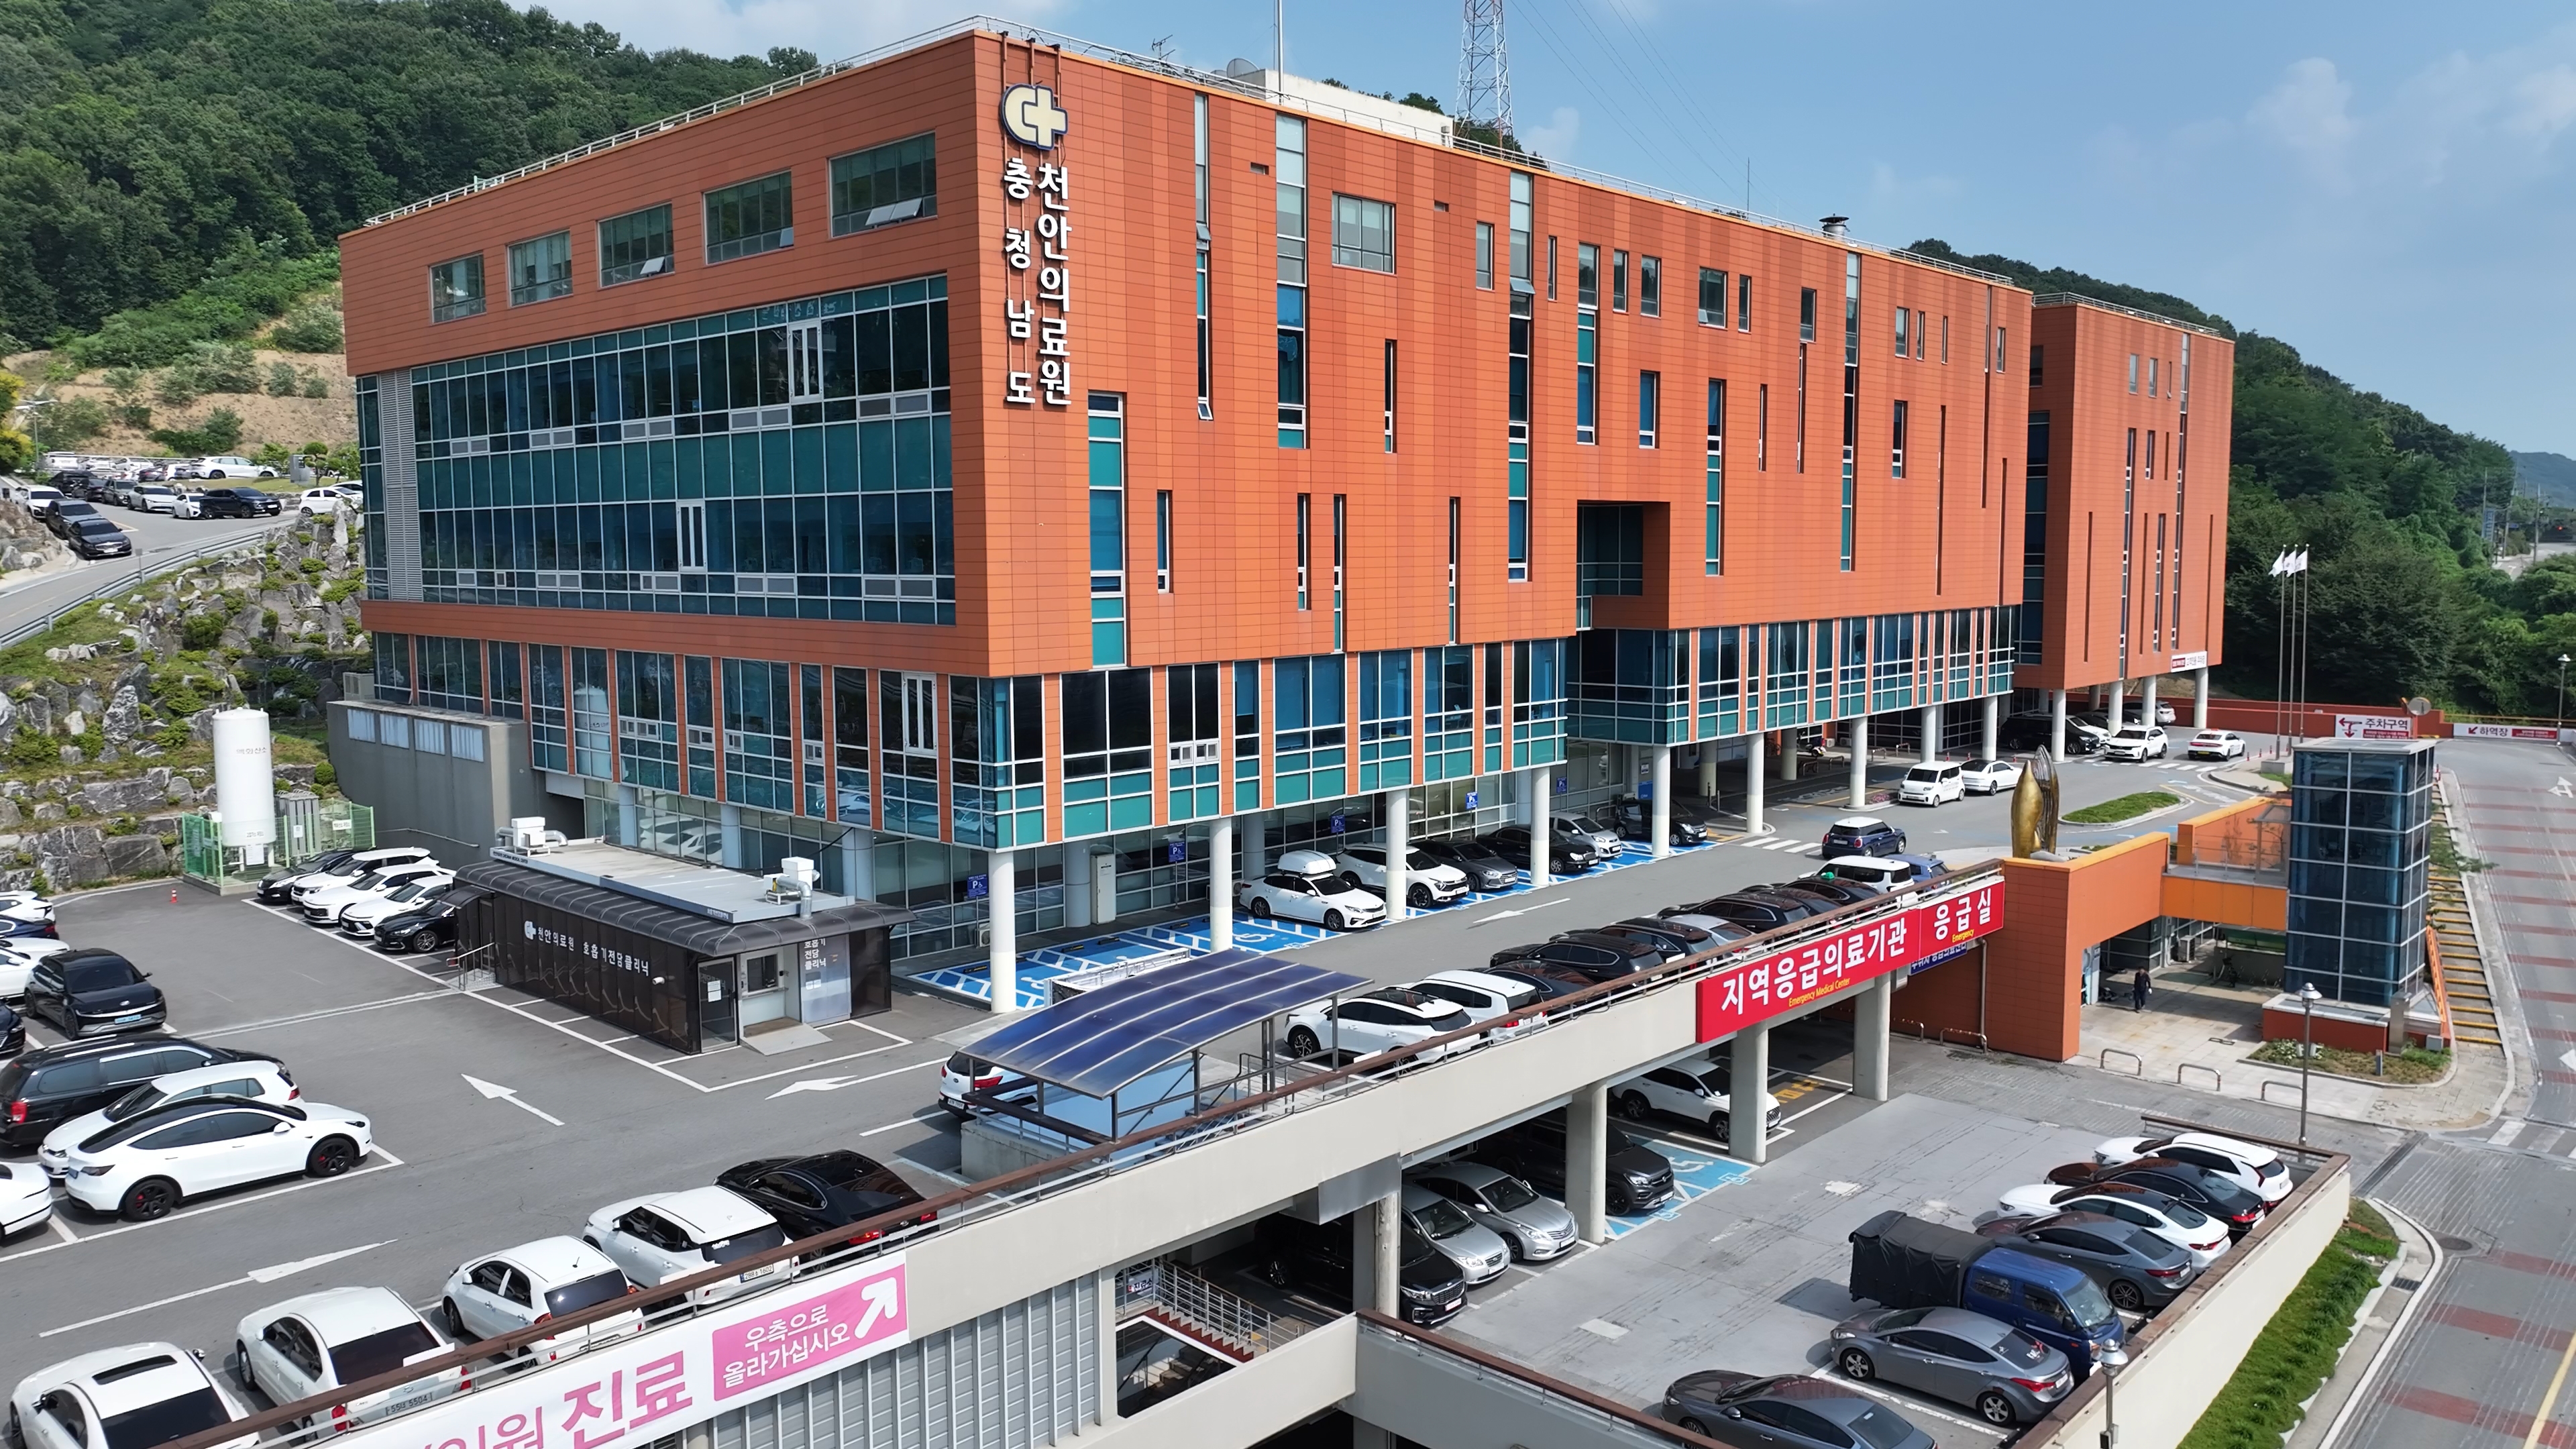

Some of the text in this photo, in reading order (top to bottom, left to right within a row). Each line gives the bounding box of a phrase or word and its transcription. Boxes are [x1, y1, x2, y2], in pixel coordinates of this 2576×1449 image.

[1004, 158, 1036, 405] 충청남도
[1037, 162, 1073, 406] 천안의료원
[2365, 718, 2408, 730] 주차구역
[2479, 727, 2508, 737] 하역장
[973, 880, 978, 889] P
[1934, 888, 1991, 941] 응급실
[804, 938, 826, 949] 호흡기
[1952, 929, 1974, 943] Emergency
[538, 926, 649, 977] 천안의료원 호흡기전담클리닉
[804, 949, 819, 959] 전담
[804, 957, 826, 970] 클리닉
[1721, 917, 1907, 1015] 지역응급의료기관
[1788, 977, 1851, 1007] Emergency Medical Center
[745, 1304, 829, 1352] 우측으로
[723, 1323, 851, 1389] 올라가십시오
[408, 1394, 428, 1407] 5504
[561, 1350, 693, 1449] 진료
